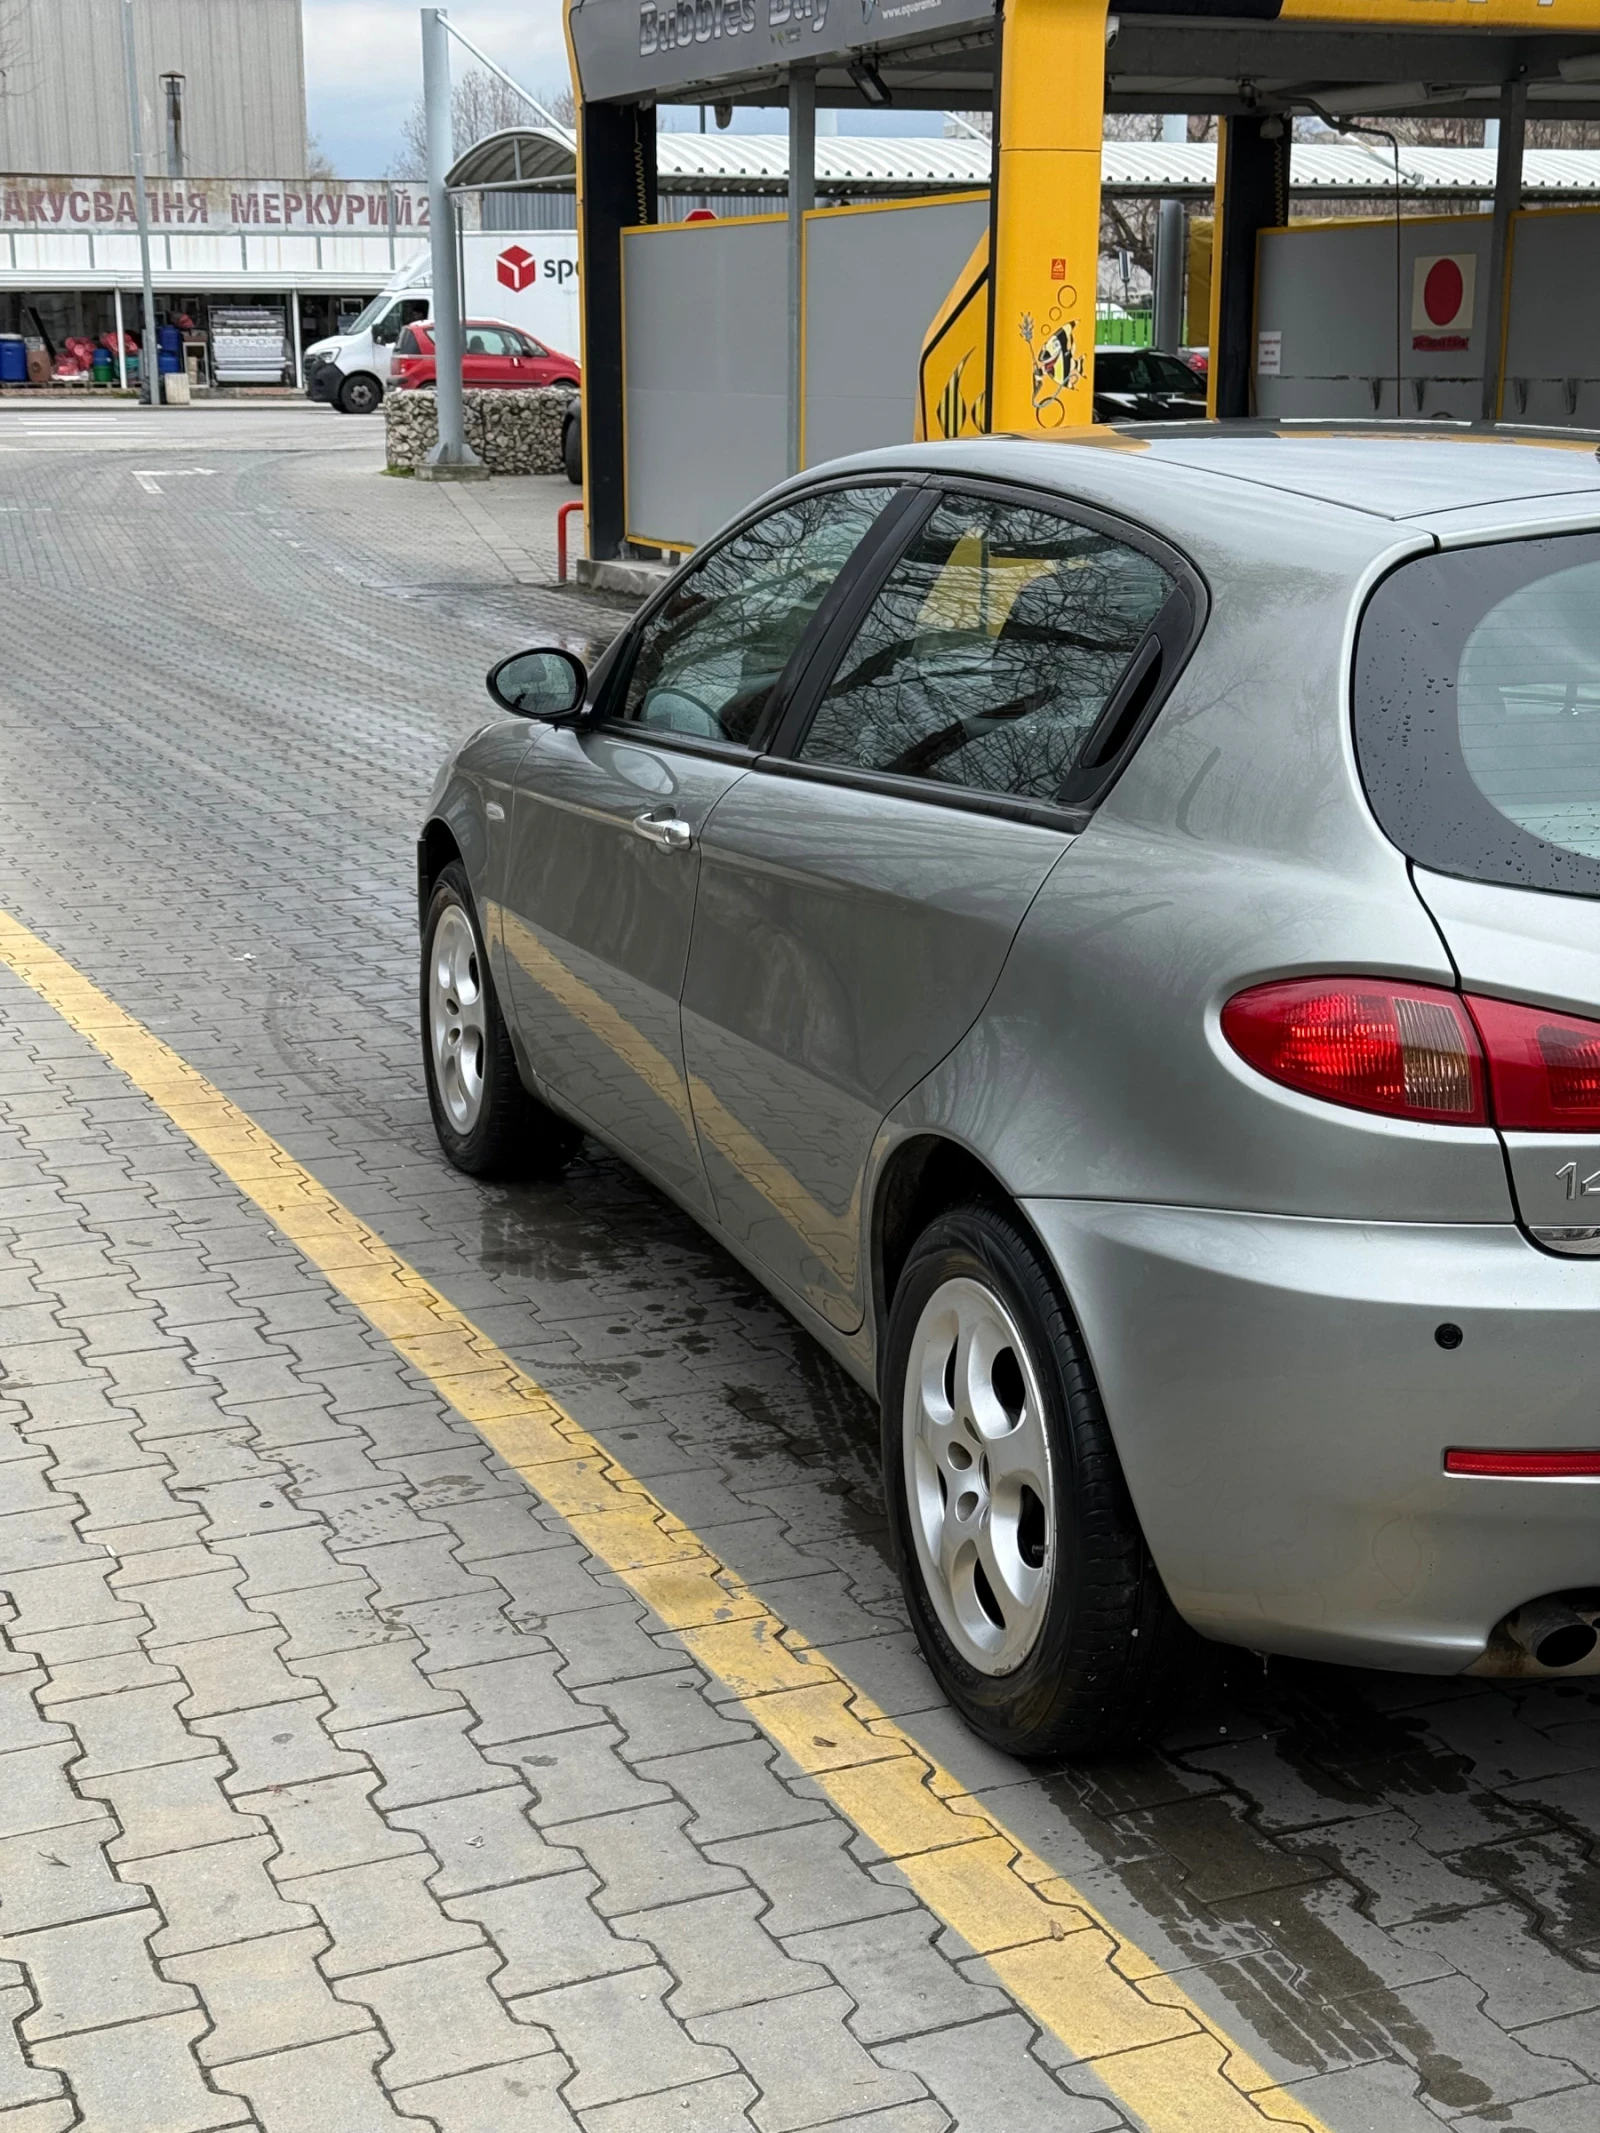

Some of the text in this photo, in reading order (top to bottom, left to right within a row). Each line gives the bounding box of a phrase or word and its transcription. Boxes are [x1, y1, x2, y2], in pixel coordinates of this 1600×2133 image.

[640, 0, 755, 57] Bubbles
[0, 191, 209, 224] АКУСВАЛНЯ
[543, 259, 579, 285] sp
